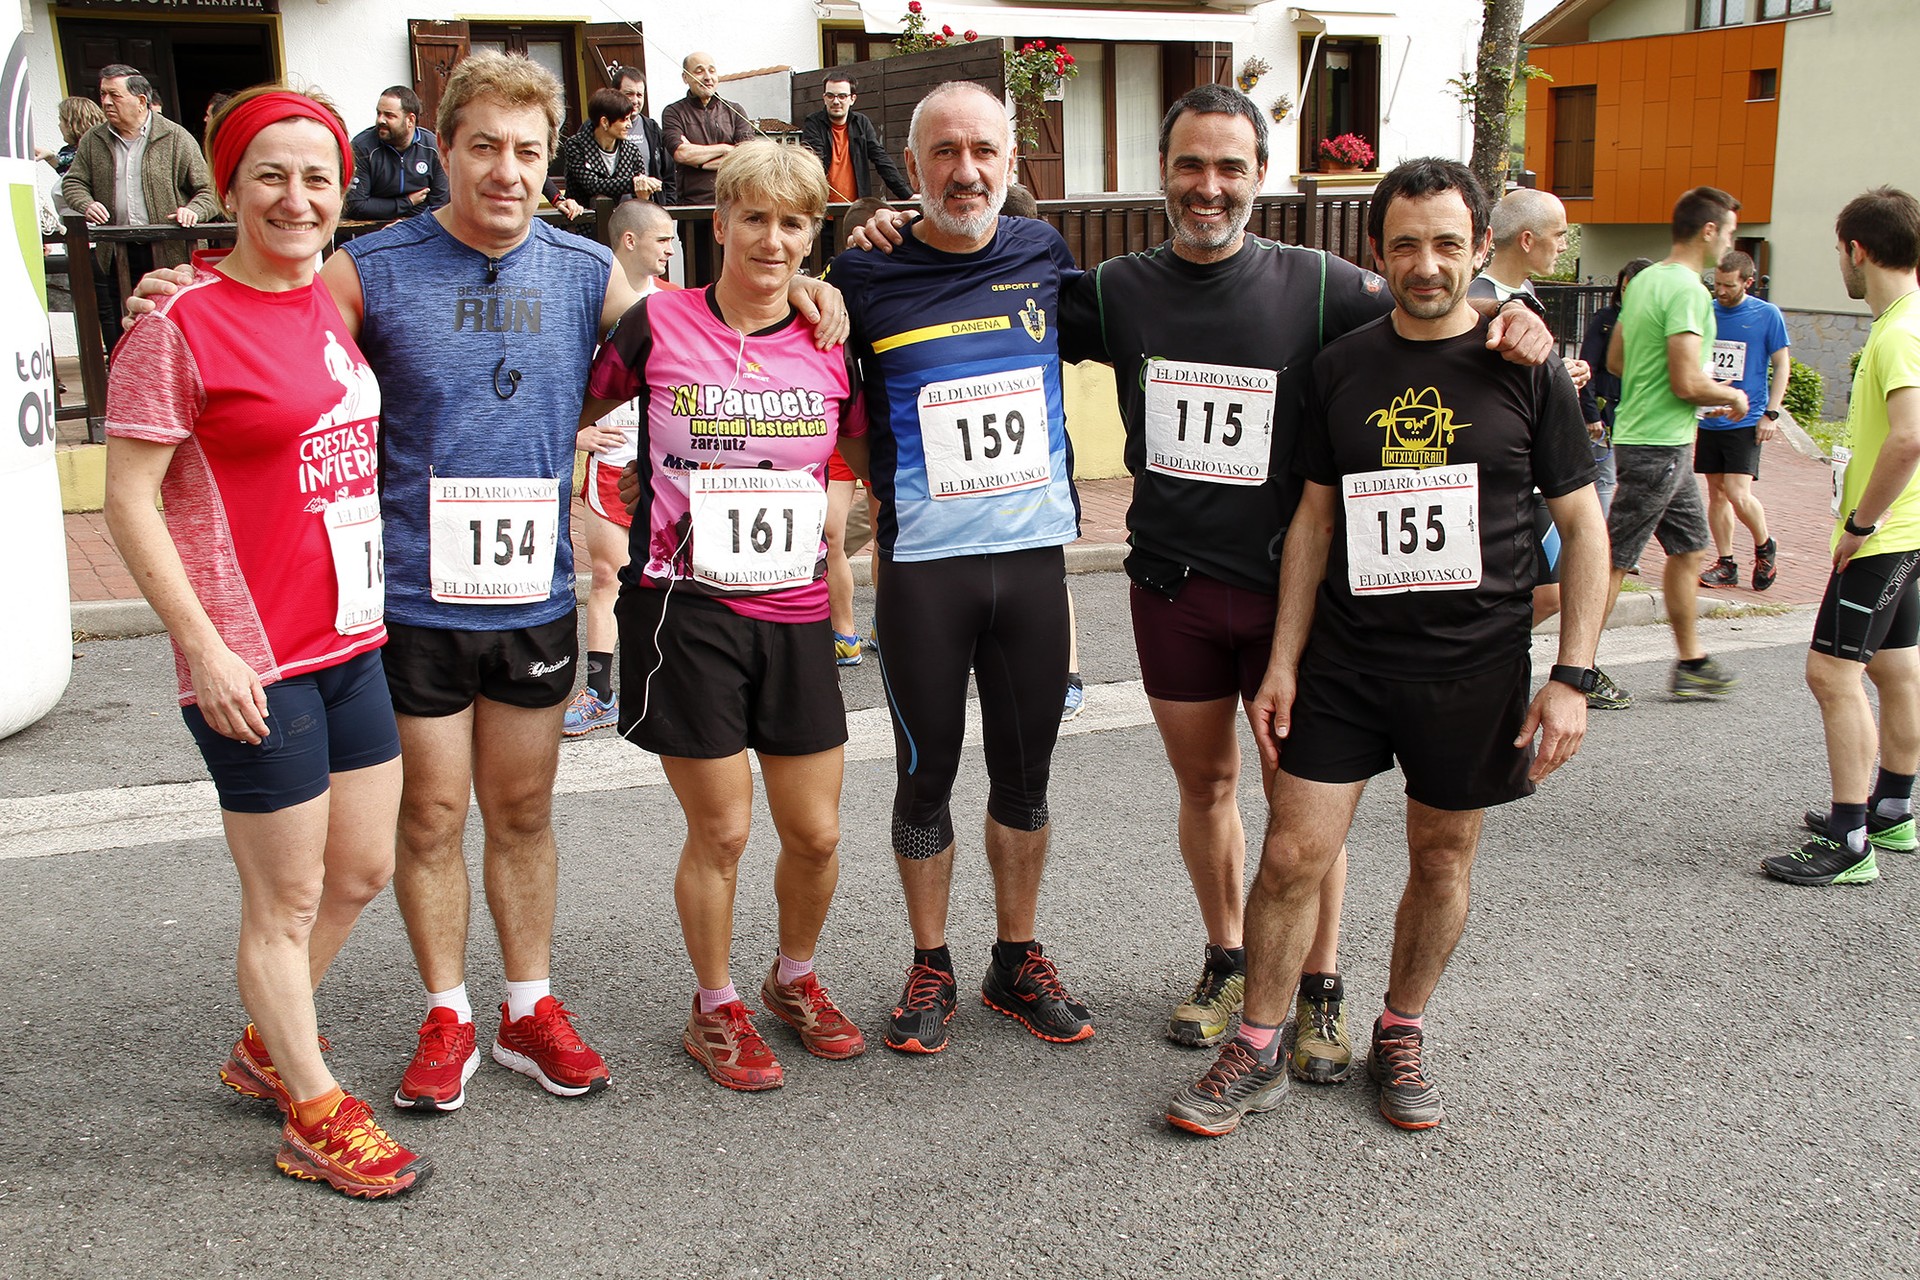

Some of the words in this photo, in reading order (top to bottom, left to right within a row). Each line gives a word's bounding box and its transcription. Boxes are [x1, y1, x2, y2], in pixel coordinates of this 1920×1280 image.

[454, 298, 542, 333] RUN
[951, 319, 1002, 334] DANENA
[928, 391, 947, 403] EL
[949, 383, 997, 400] DIARIO
[999, 375, 1036, 391] VASCO
[1156, 368, 1172, 380] EL
[1175, 370, 1224, 382] DIARIO
[1226, 374, 1269, 389] VASCO
[667, 384, 703, 416] XV.
[703, 384, 826, 421] Pagoeta
[690, 418, 746, 437] mendi
[749, 418, 828, 437] lasterketa
[956, 409, 1025, 461] 159
[1177, 399, 1243, 447] 115
[299, 423, 369, 462] CRESTAS
[690, 437, 747, 452] zarautz
[1154, 453, 1168, 465] EL
[1170, 456, 1216, 471] DIARIO
[1218, 463, 1259, 477] VASCO
[443, 486, 461, 498] EL
[465, 486, 517, 498] DIARIO
[519, 486, 552, 498] VASCO
[702, 477, 720, 489] EL
[723, 477, 774, 489] DIARIO
[776, 478, 817, 488] VASCO
[940, 480, 959, 493] EL
[960, 472, 1010, 491] DIARIO
[1011, 466, 1046, 482] VASCO
[1354, 481, 1372, 493] EL
[1373, 476, 1421, 491] DIARIO
[1423, 472, 1468, 486] VASCO
[469, 518, 535, 566] 154
[728, 508, 793, 554] 161
[1377, 505, 1446, 555] 155
[704, 570, 723, 581] EL
[724, 570, 772, 583] DIARIO
[773, 566, 808, 580] VASCO
[1359, 574, 1376, 587] EL
[1377, 570, 1426, 586] DIARIO
[1427, 567, 1472, 581] VASCO
[443, 582, 461, 594] EL
[465, 582, 518, 595] DIARIO
[520, 582, 550, 594] VASCO
[243, 1056, 277, 1089] SPORTIVA
[292, 1137, 329, 1167] SPORTIVA
